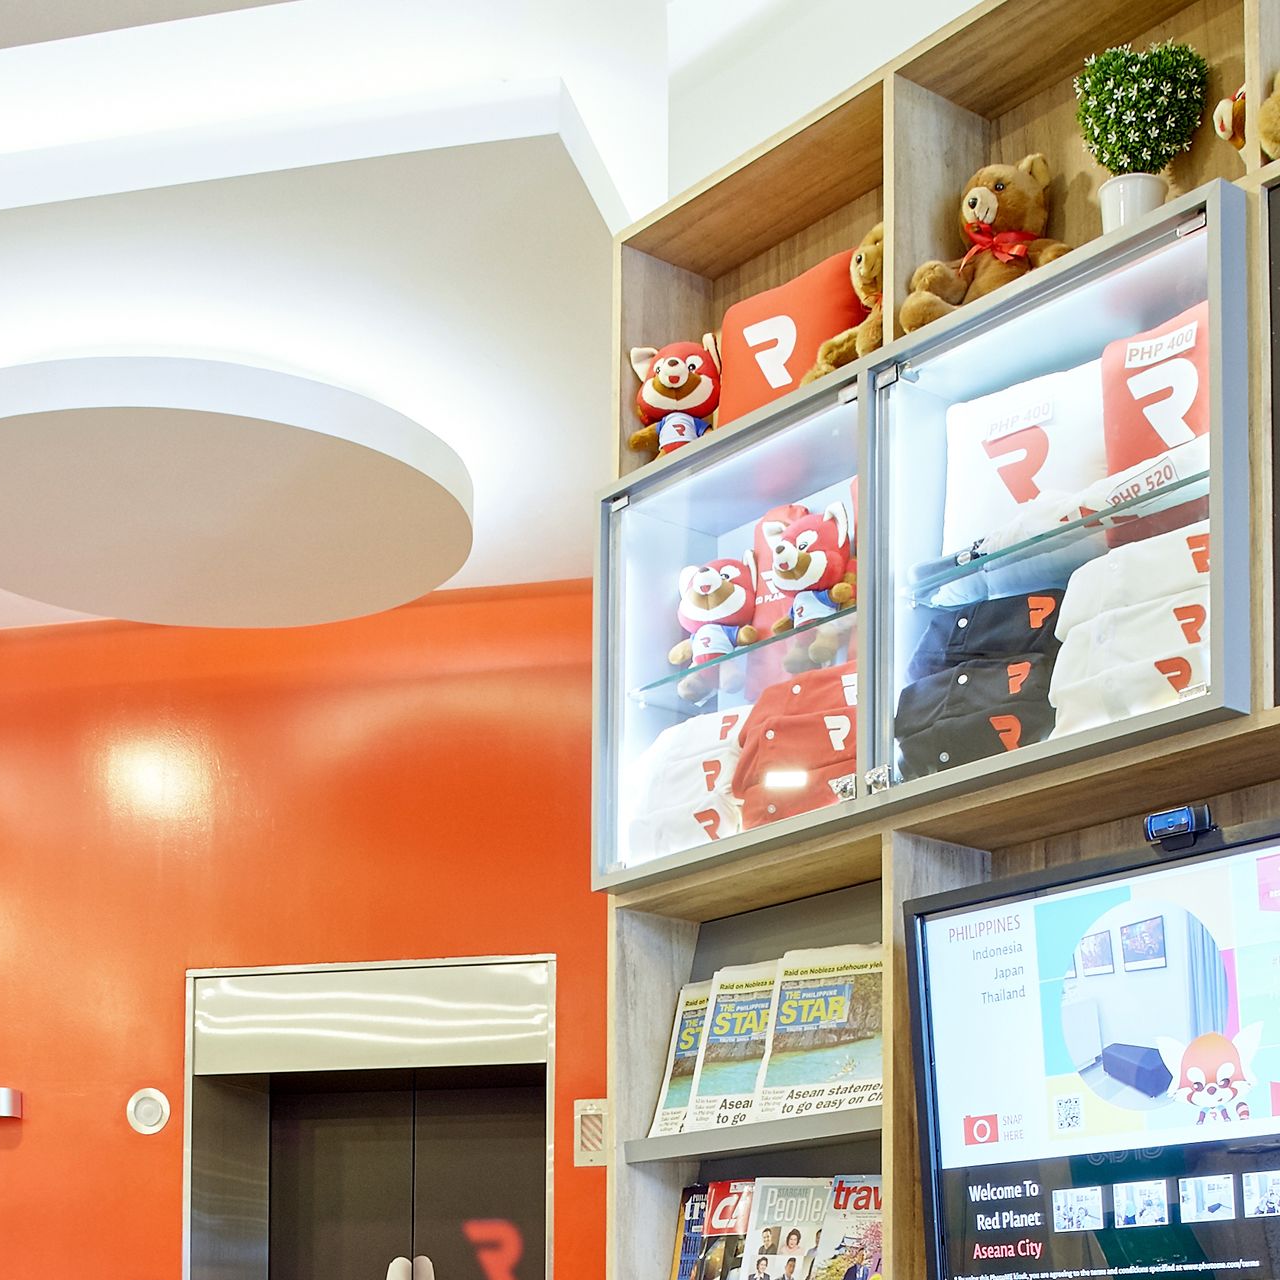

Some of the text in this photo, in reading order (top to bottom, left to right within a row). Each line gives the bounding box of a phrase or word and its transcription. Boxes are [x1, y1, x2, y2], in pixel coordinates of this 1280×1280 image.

[1128, 327, 1196, 364] PHP 400
[988, 401, 1051, 437] PHP 400
[1145, 463, 1174, 494] 520
[948, 915, 1021, 943] PHILIPPINES
[972, 942, 1023, 961] Indonesia
[994, 964, 1024, 981] Japan
[785, 990, 801, 998] THE
[981, 986, 1026, 1004] Thailand
[779, 996, 847, 1024] STAR
[782, 1104, 794, 1114] to
[796, 1102, 813, 1114] go
[816, 1098, 845, 1110] easy
[848, 1095, 862, 1105] on
[786, 1089, 824, 1101] Asean
[1002, 1114, 1024, 1127] SNAP
[1003, 1129, 1024, 1140] HERE
[968, 1181, 1039, 1202] Welcome To
[976, 1211, 1041, 1231] Red Planet
[973, 1240, 1042, 1260] Aseana City
